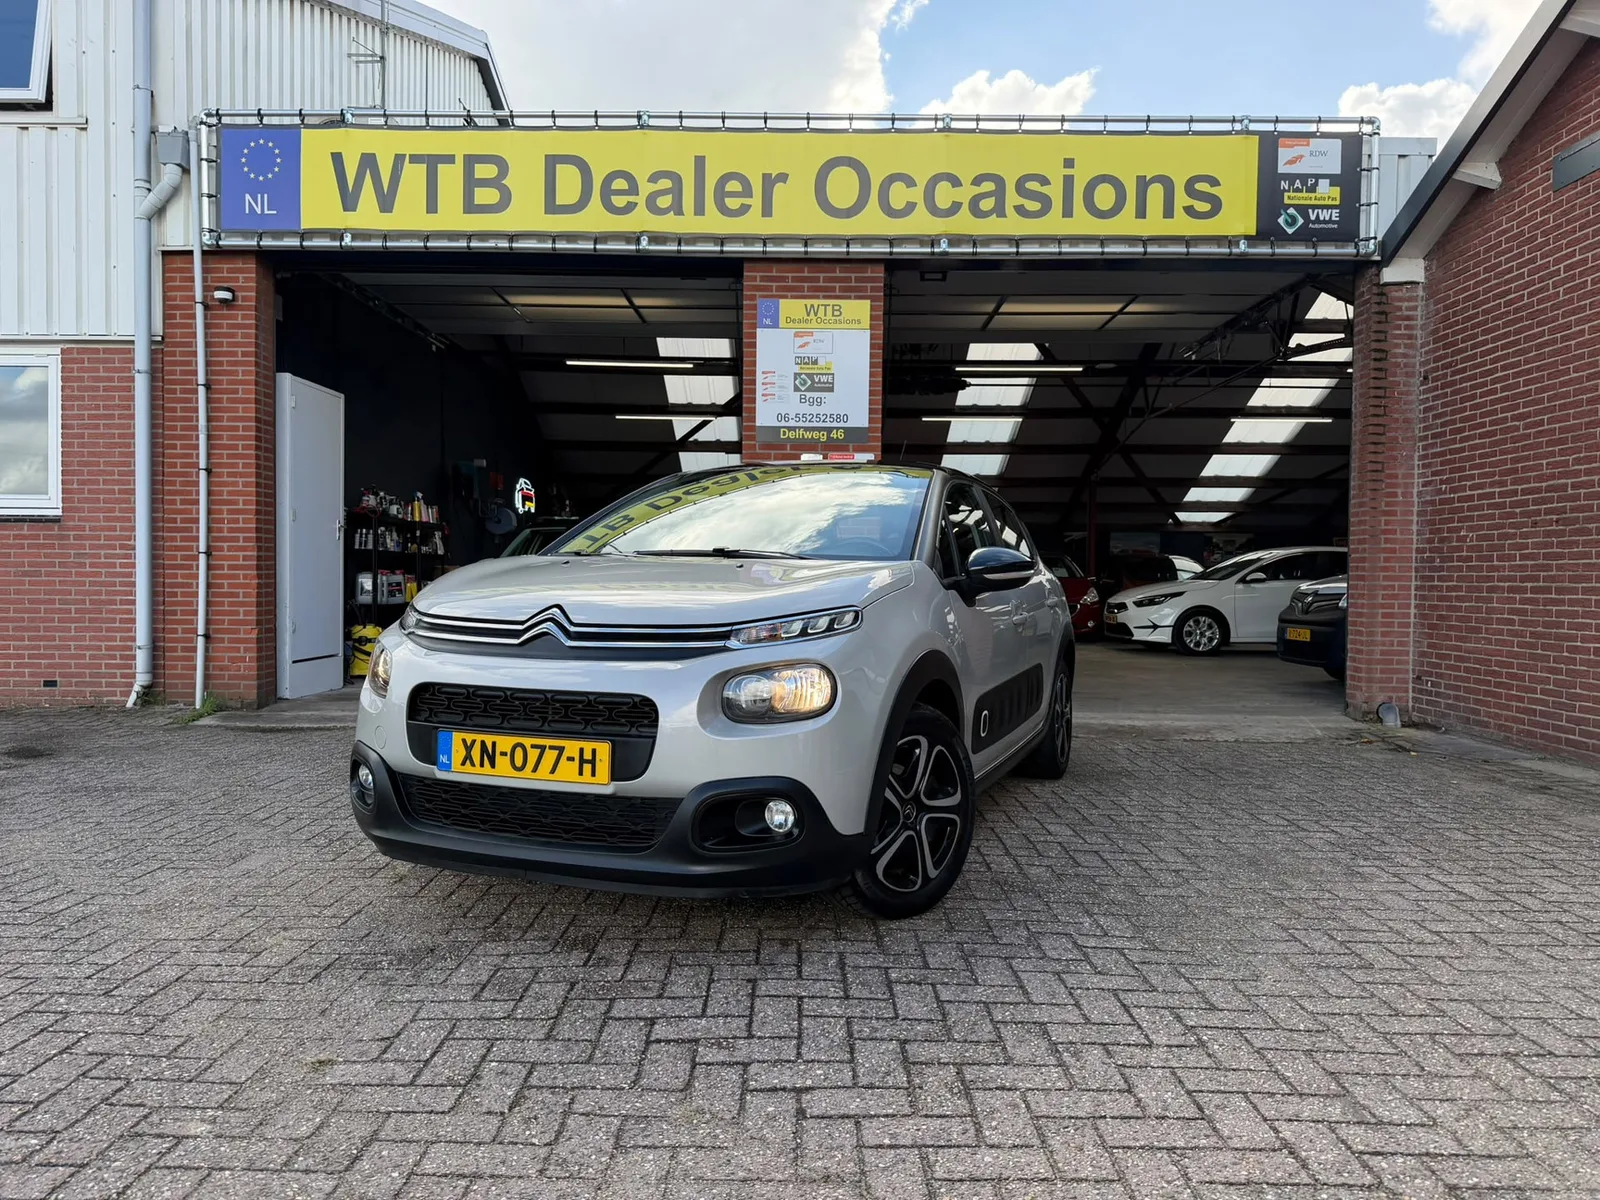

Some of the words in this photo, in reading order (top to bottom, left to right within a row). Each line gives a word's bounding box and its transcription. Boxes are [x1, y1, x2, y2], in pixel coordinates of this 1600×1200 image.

[329, 152, 513, 216] WTB
[543, 154, 789, 219] Dealer
[813, 155, 1224, 220] Occasions
[244, 193, 277, 215] NL
[1287, 194, 1312, 202] Nationale
[1313, 194, 1326, 202] Auto
[1308, 209, 1340, 220] VWE
[804, 304, 843, 317] WTB
[785, 317, 813, 325] Dealer
[814, 317, 862, 325] Occasions
[813, 374, 834, 383] VWE
[799, 394, 827, 406] Bgg:
[776, 412, 849, 424] 06-55252580
[780, 428, 828, 442] Delfweg
[830, 429, 845, 439] 46
[439, 755, 450, 764] NL
[460, 738, 597, 778] XN-077-H
